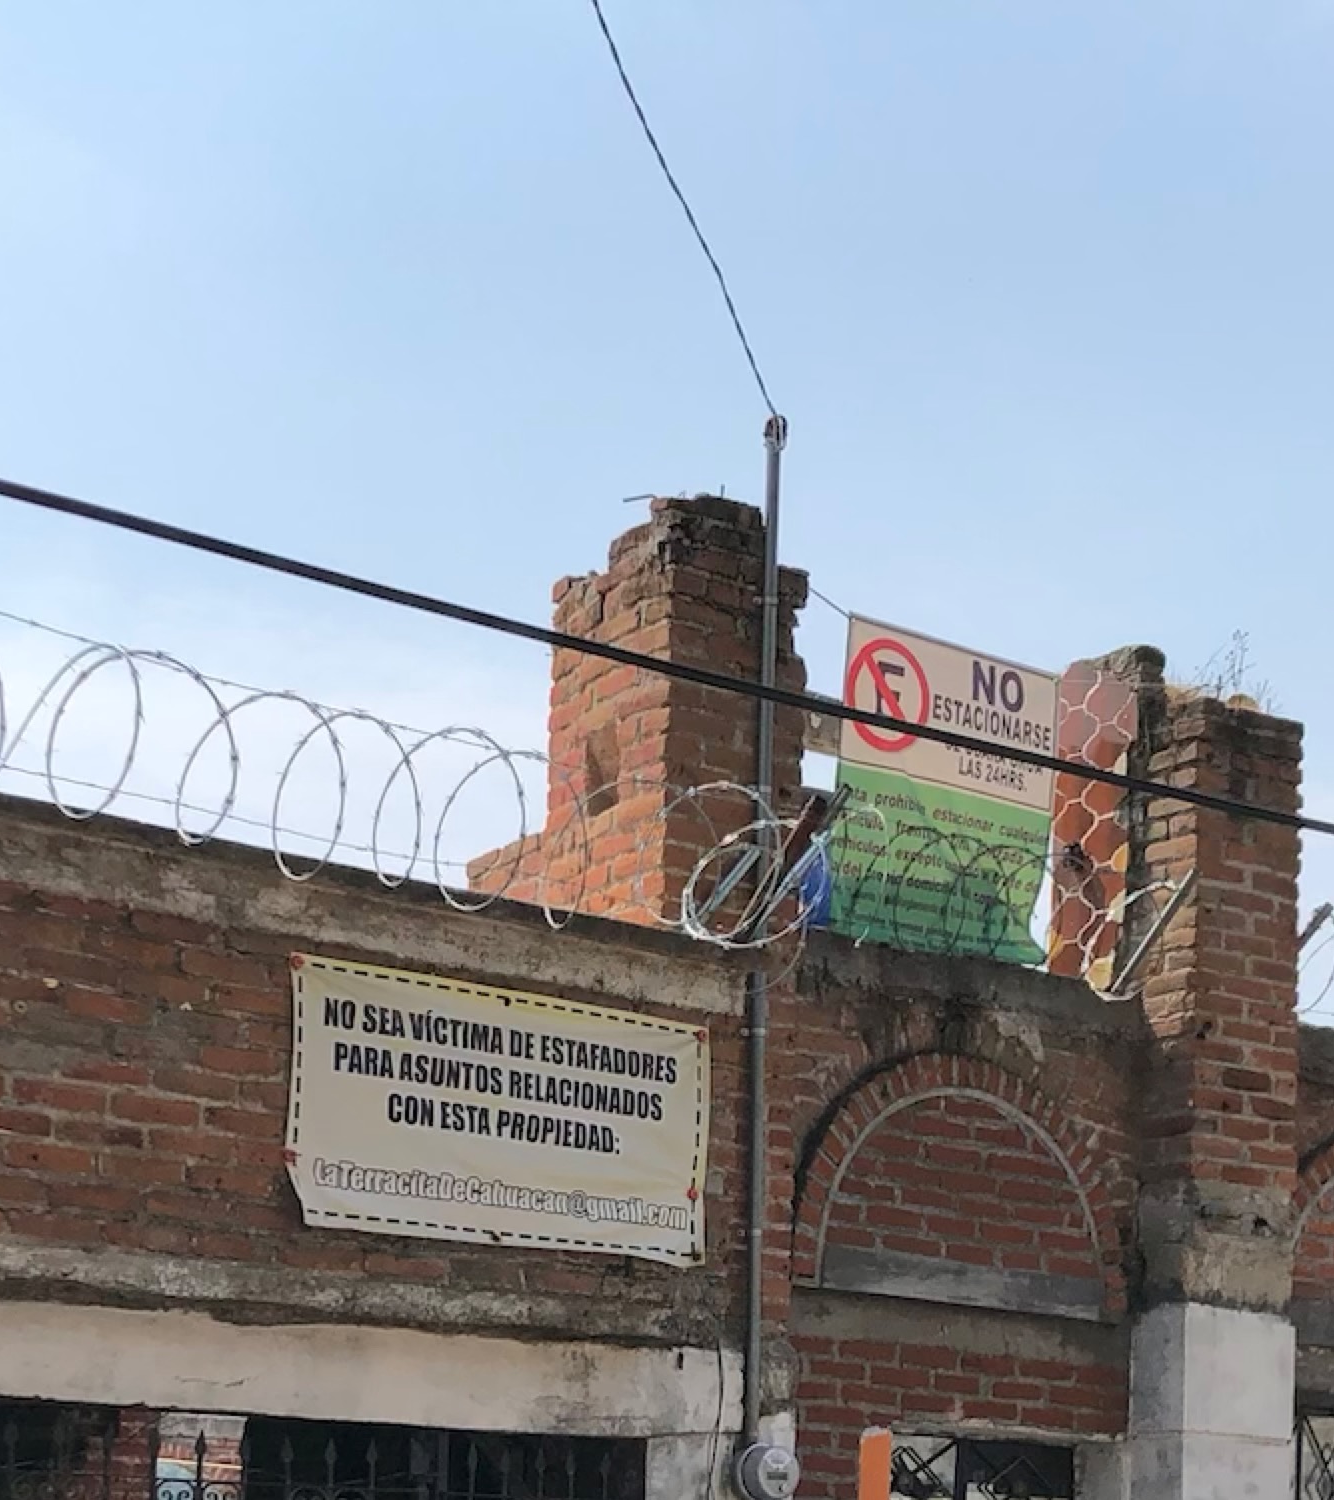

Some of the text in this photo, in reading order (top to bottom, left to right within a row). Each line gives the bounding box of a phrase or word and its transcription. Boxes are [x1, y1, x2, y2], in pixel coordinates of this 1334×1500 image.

[972, 659, 1025, 713] NO
[932, 697, 1052, 751] ESTACIONARSE
[958, 755, 982, 780] LAS
[323, 996, 678, 1084] NO SEA VÍCTIMA DE ESTAFADORES
[333, 1041, 663, 1122] PARA ASUNTOS RELACIONADOS
[387, 1092, 621, 1155] CON ESTA PROPIEDAD:
